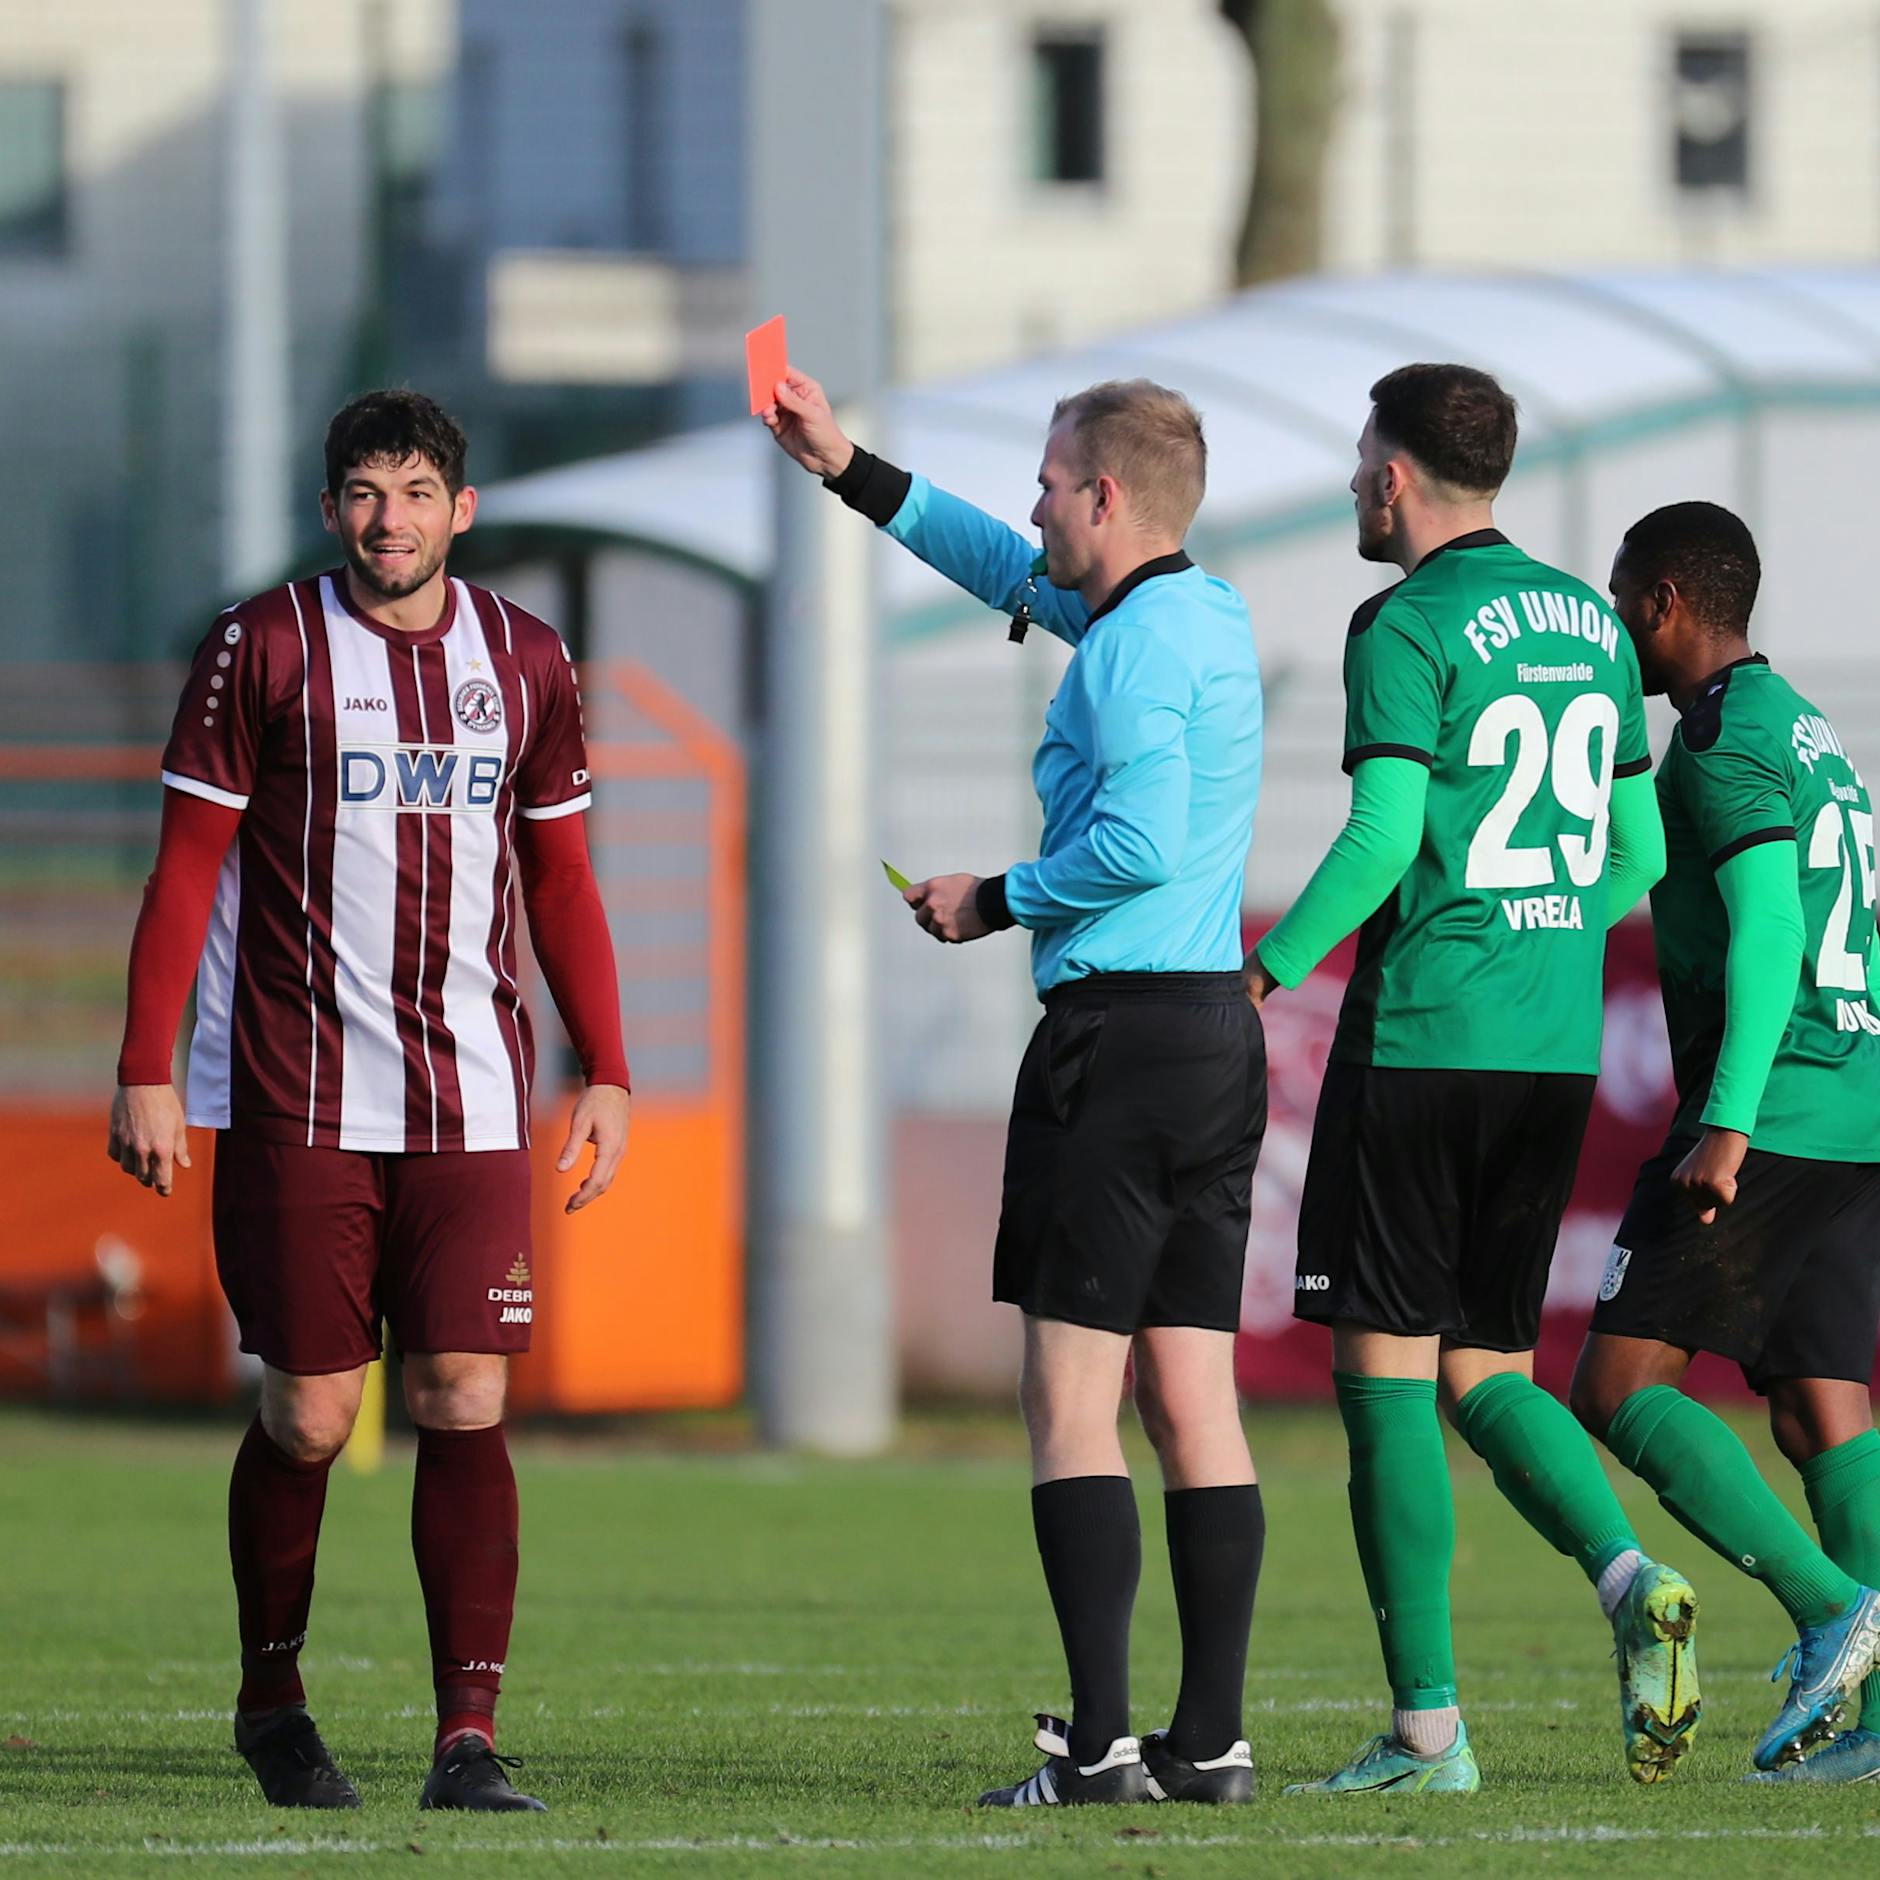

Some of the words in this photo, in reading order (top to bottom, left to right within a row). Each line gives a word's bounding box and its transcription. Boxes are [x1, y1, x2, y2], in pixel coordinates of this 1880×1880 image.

[1464, 595, 1521, 664] FSV
[1518, 591, 1619, 663] UNION
[1516, 662, 1594, 683] Fürstenwalde
[343, 697, 388, 712] JAKO
[340, 750, 503, 806] DWB
[1465, 693, 1620, 889] 29
[1501, 895, 1584, 931] VRELA
[1295, 1274, 1330, 1291] AKO
[499, 1306, 533, 1324] JAKO
